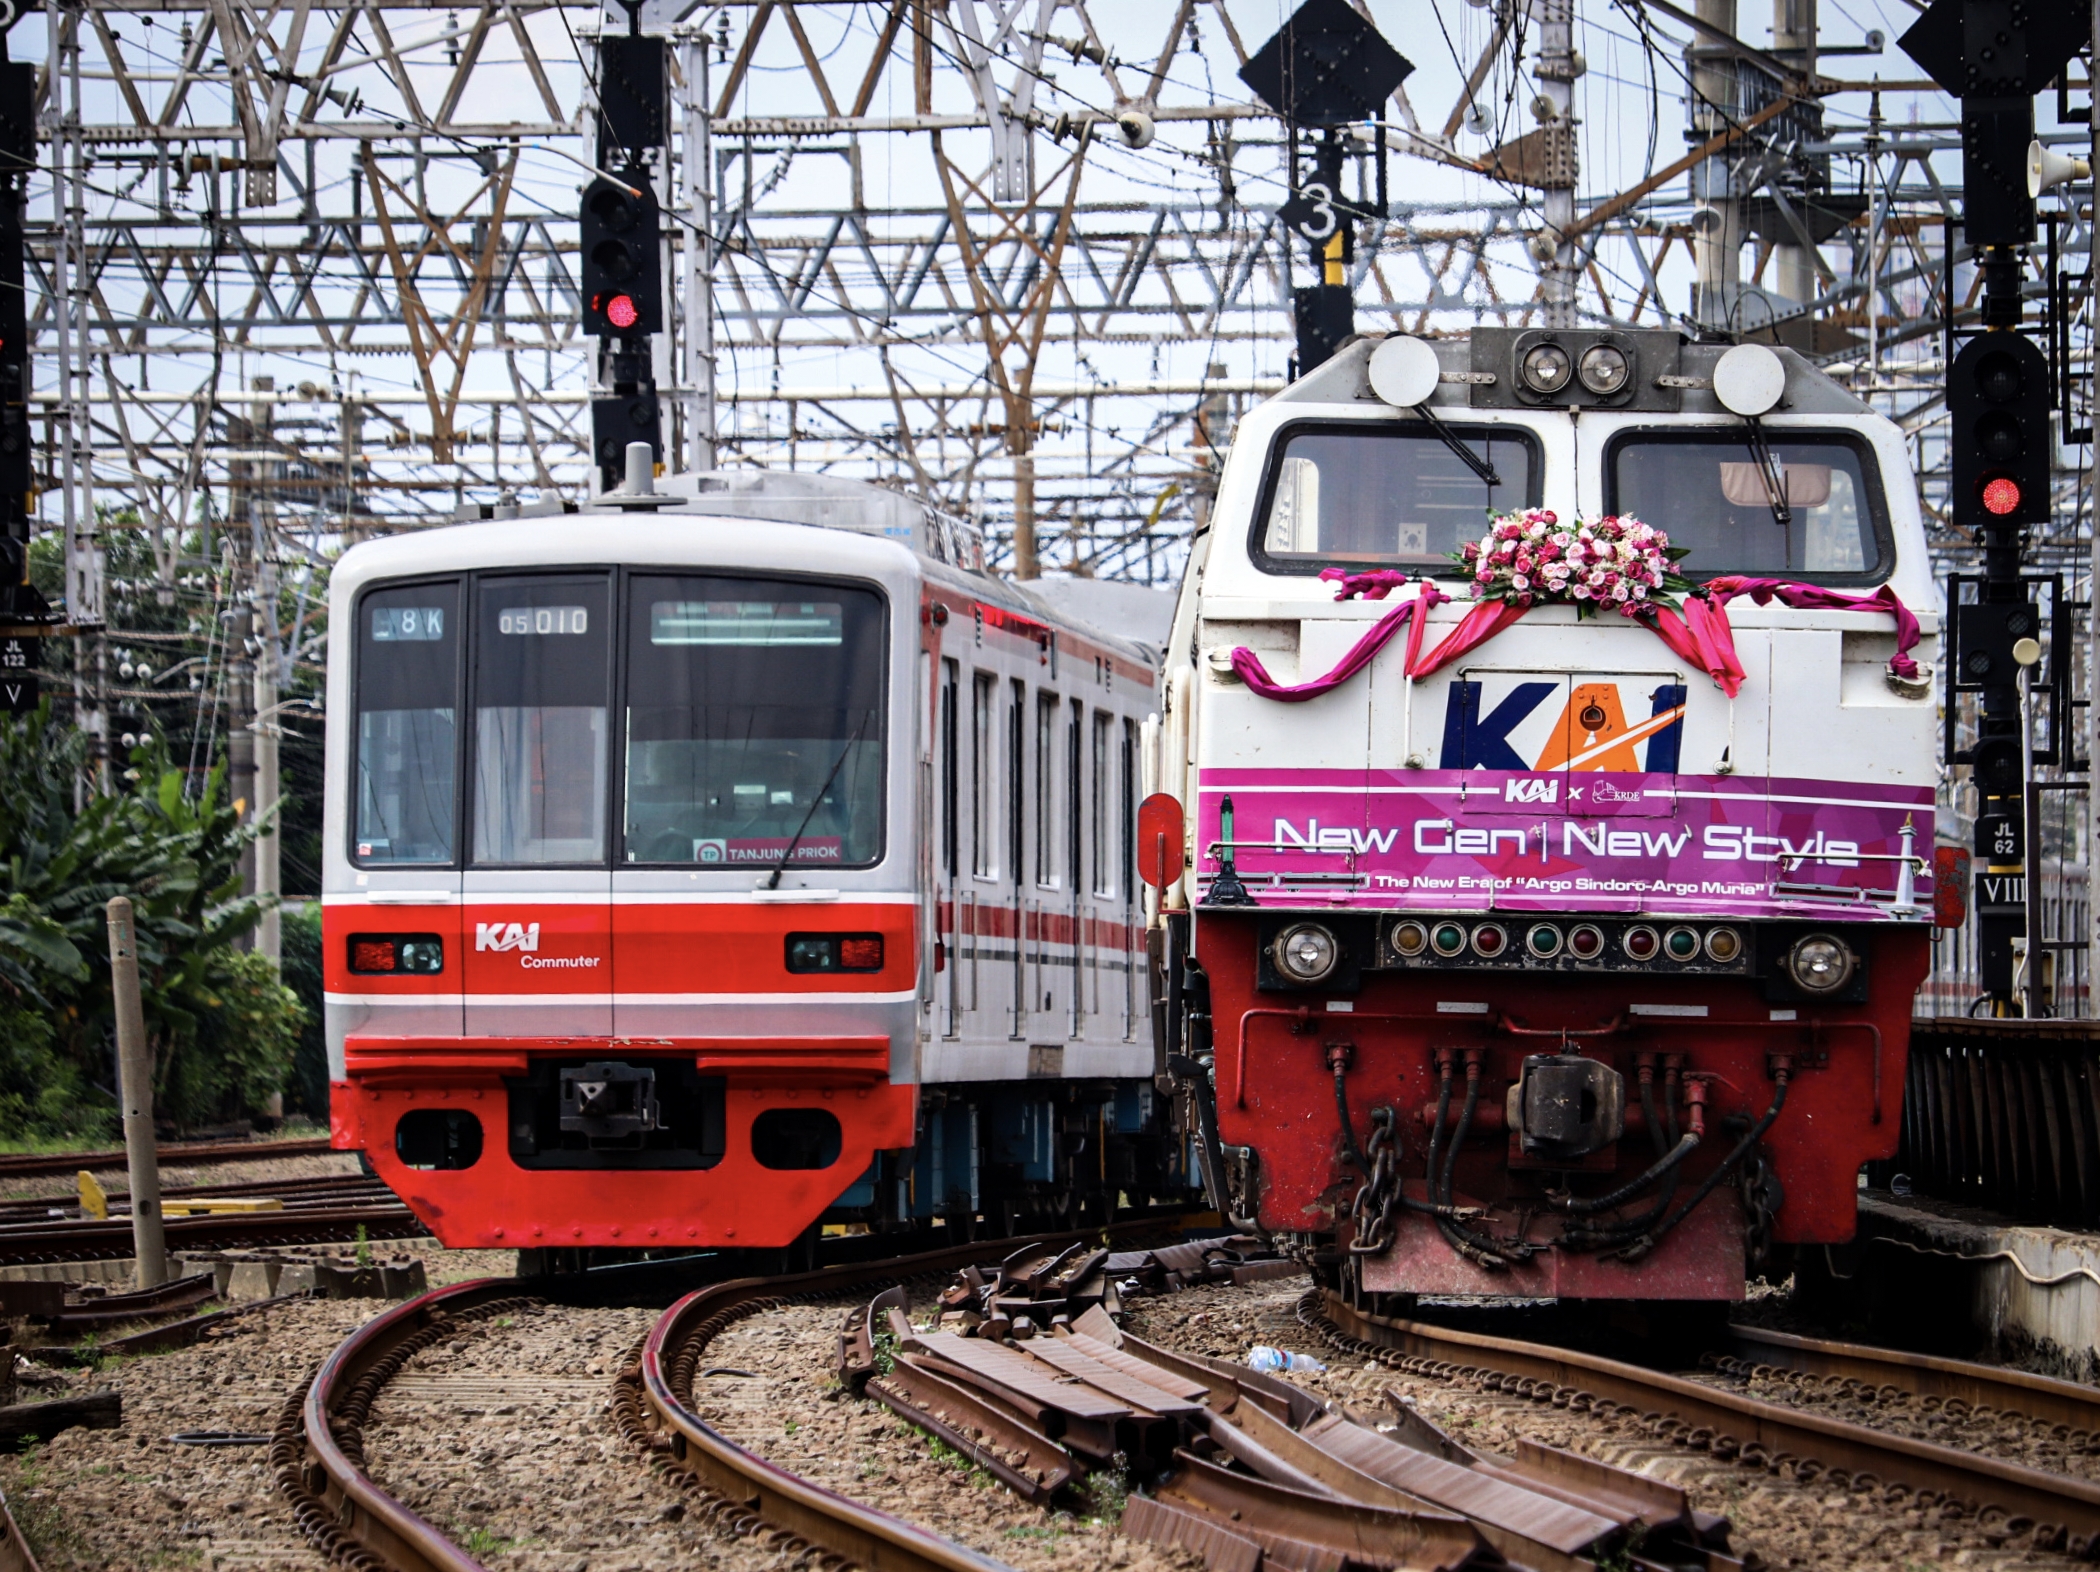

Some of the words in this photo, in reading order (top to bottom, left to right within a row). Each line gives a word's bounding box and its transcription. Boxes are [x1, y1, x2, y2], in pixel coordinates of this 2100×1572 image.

[1299, 183, 1336, 240] 3
[5, 640, 22, 653] JL
[2, 654, 26, 667] 122
[5, 684, 22, 705] V
[1439, 680, 1688, 774] KAI
[1505, 778, 1558, 803] KAI
[1614, 790, 1640, 800] KRDE
[1994, 822, 2014, 836] JL
[797, 846, 838, 859] PRIOK
[1274, 817, 1399, 854] New
[1414, 819, 1527, 855] Gen
[1562, 821, 1688, 858] New
[1702, 824, 1860, 871] Style
[1994, 839, 2014, 854] 62
[703, 851, 716, 859] TP
[1374, 875, 1410, 888] The
[1413, 876, 1454, 889] New
[1458, 876, 1490, 889] Era
[1493, 876, 1513, 890] of
[1575, 878, 1698, 896] Sindoro-Argo
[1983, 877, 2027, 903] VIII
[475, 922, 540, 952] KAI
[520, 954, 600, 969] Commuter
